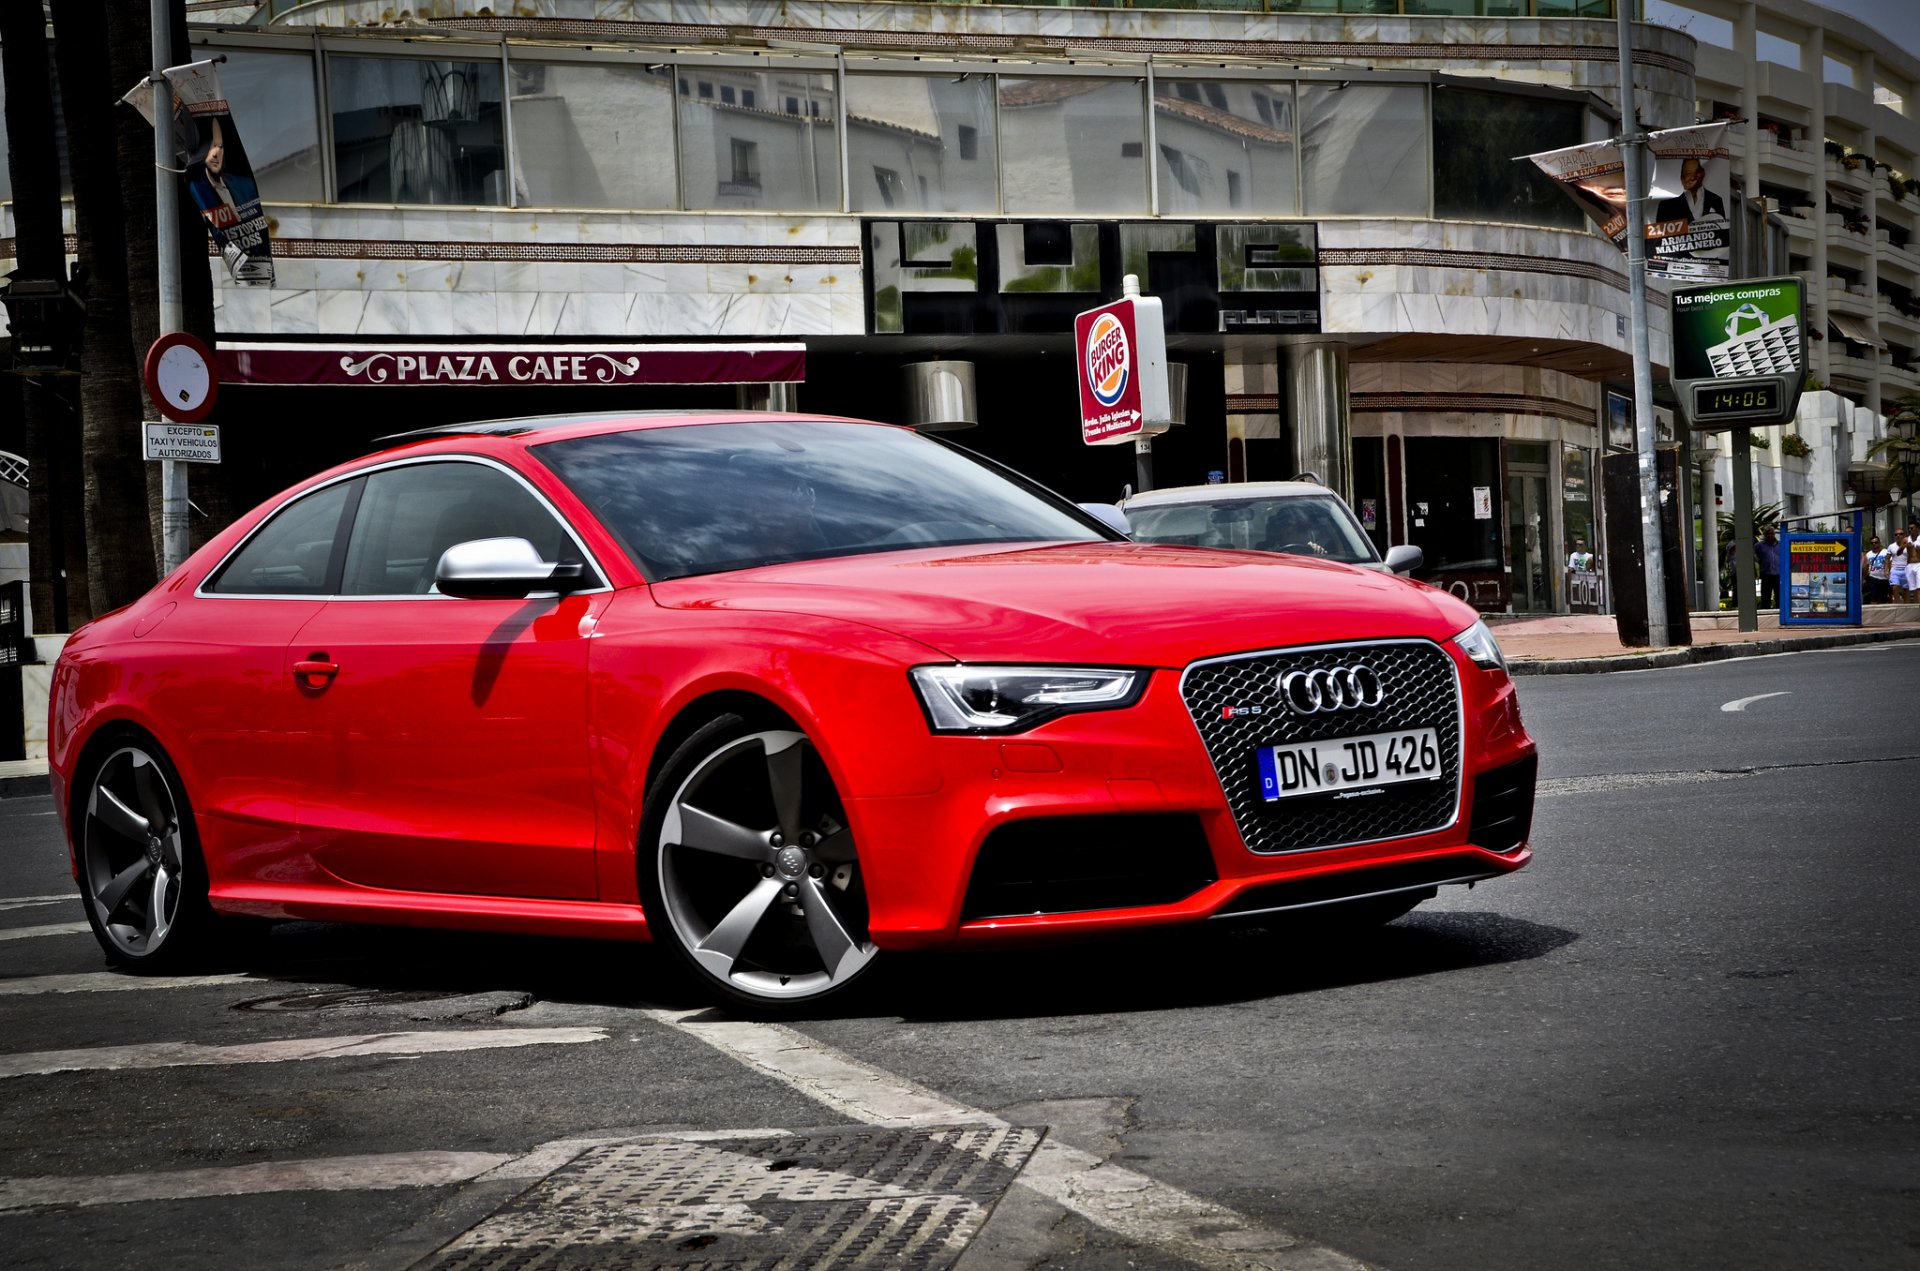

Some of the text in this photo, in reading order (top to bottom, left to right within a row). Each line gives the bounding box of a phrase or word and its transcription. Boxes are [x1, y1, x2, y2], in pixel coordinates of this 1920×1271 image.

[1603, 214, 1625, 235] 22/07
[1647, 221, 1684, 237] 21/07
[1655, 238, 1722, 254] MANZANERO
[1661, 231, 1715, 247] ARMANDO
[1675, 287, 1781, 305] Tus mejores compras
[1091, 326, 1122, 368] BURGER
[397, 356, 588, 380] PLAZA CAFE
[1094, 341, 1125, 390] KING
[1714, 391, 1767, 409] 14:06
[167, 427, 202, 436] EXCEPTO
[149, 437, 218, 448] TAXI Y VEHICULOS
[158, 449, 212, 458] AUTORIZADOS
[1277, 733, 1437, 791] DN JD 426
[1265, 777, 1273, 789] D
